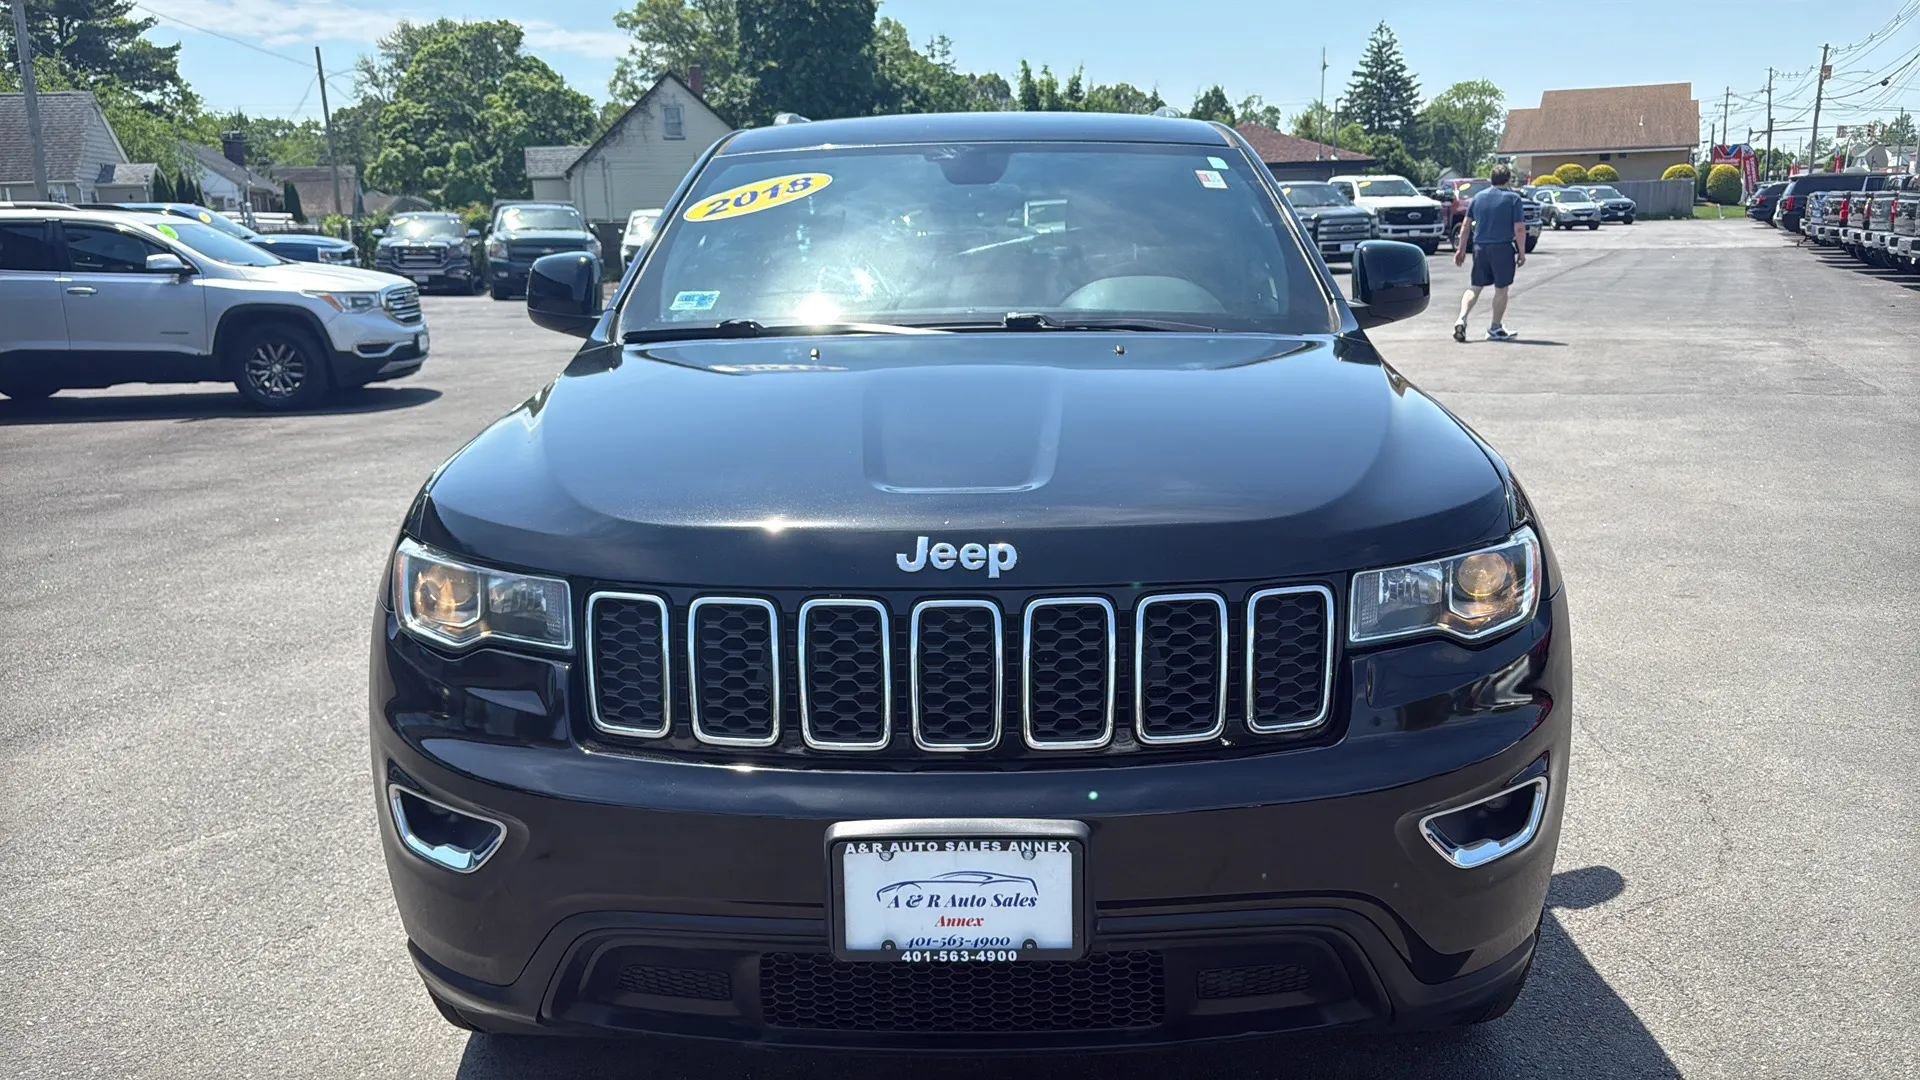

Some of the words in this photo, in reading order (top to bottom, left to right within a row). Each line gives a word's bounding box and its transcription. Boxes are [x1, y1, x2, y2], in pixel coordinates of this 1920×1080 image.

[702, 176, 813, 218] 2018
[896, 536, 1018, 578] Jeep
[845, 842, 882, 854] A&R
[890, 841, 939, 853] AUTO
[945, 841, 1001, 852] SALES
[1008, 841, 1070, 853] ANNEX
[887, 894, 900, 908] A
[906, 895, 924, 908] &
[927, 894, 941, 908] R
[944, 893, 987, 908] Auto
[991, 892, 1038, 908] Sales
[934, 914, 985, 928] Annex
[905, 934, 1011, 949] 401-563-4900
[901, 950, 1018, 963] 401-563-4900
